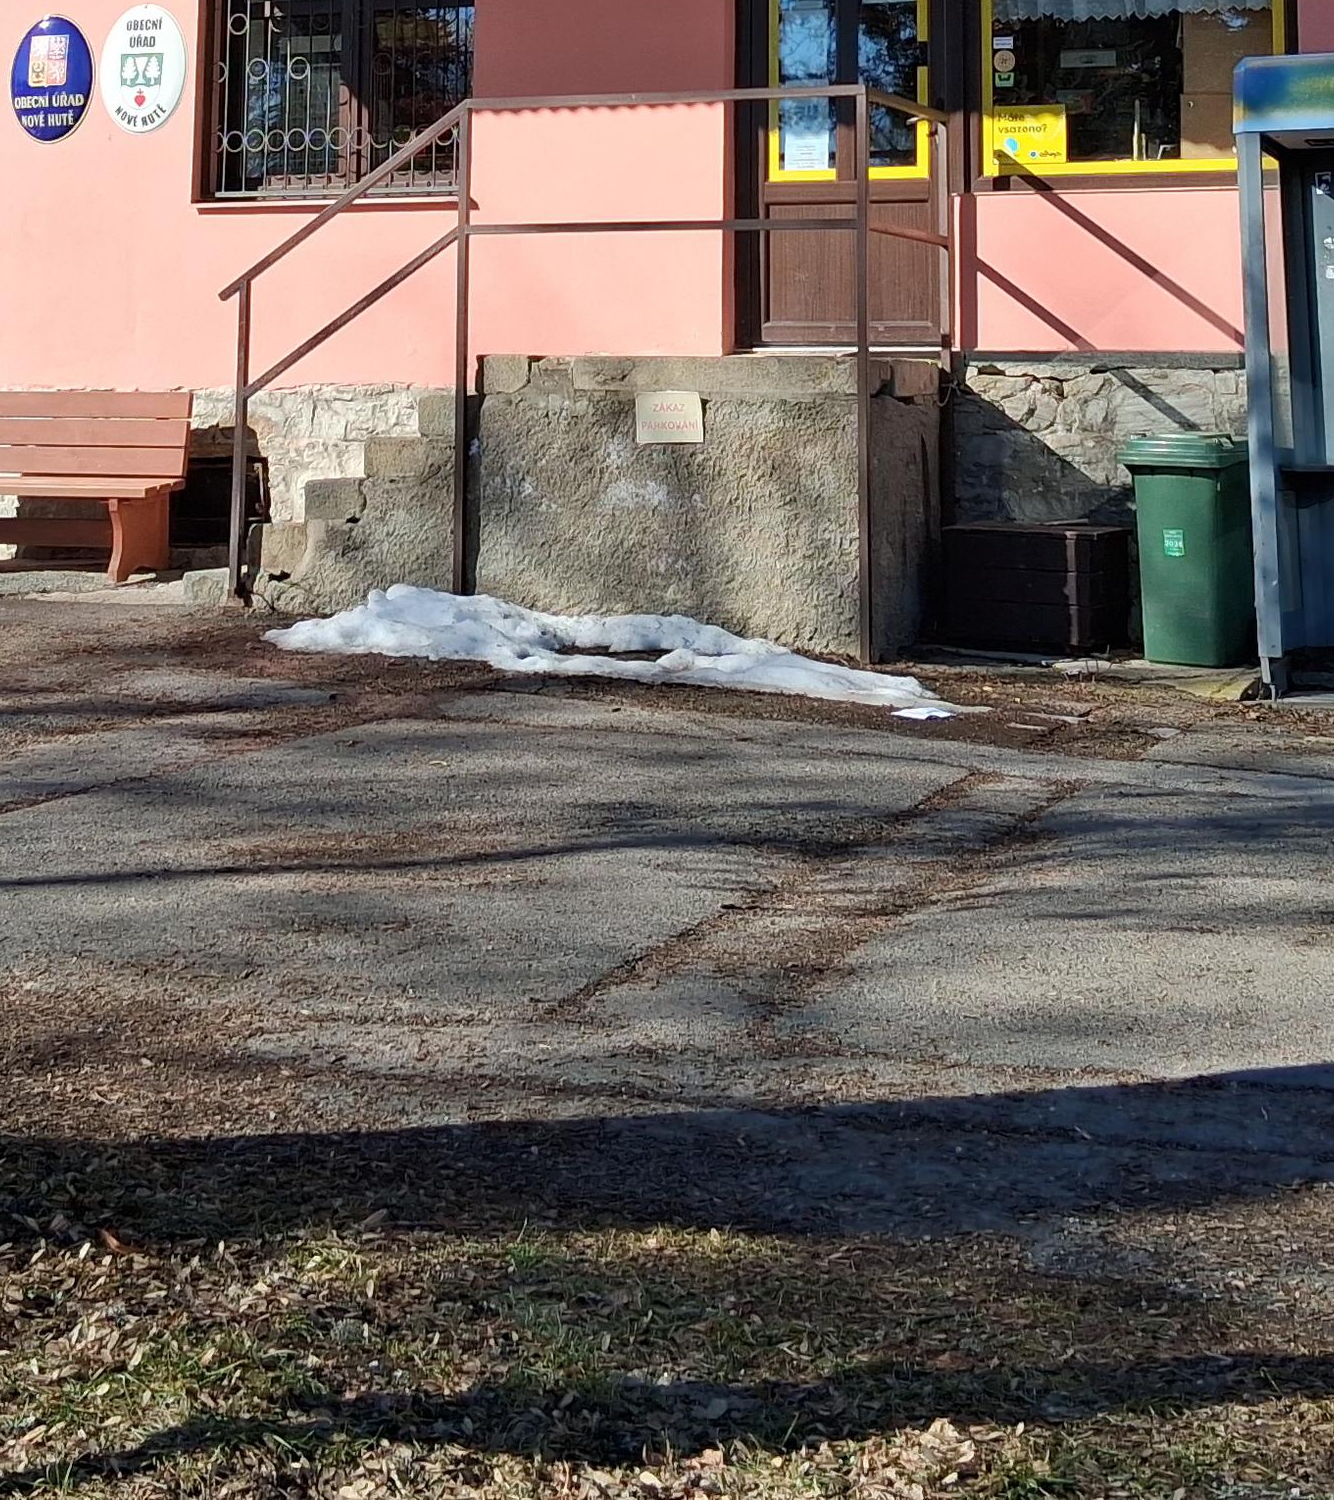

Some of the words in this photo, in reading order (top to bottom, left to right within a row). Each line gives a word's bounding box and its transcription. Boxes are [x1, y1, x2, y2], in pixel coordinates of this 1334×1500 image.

[126, 16, 164, 31] OBECNÍ
[14, 91, 49, 109] OBECNÍ
[51, 91, 85, 107] ÚŘAD
[21, 110, 46, 128] NOVÉ
[47, 109, 74, 126] HUTĚ
[115, 104, 138, 127] NOVÉ
[652, 402, 685, 413] ZÁKAZ
[641, 419, 698, 431] PARKOVÁNÍ
